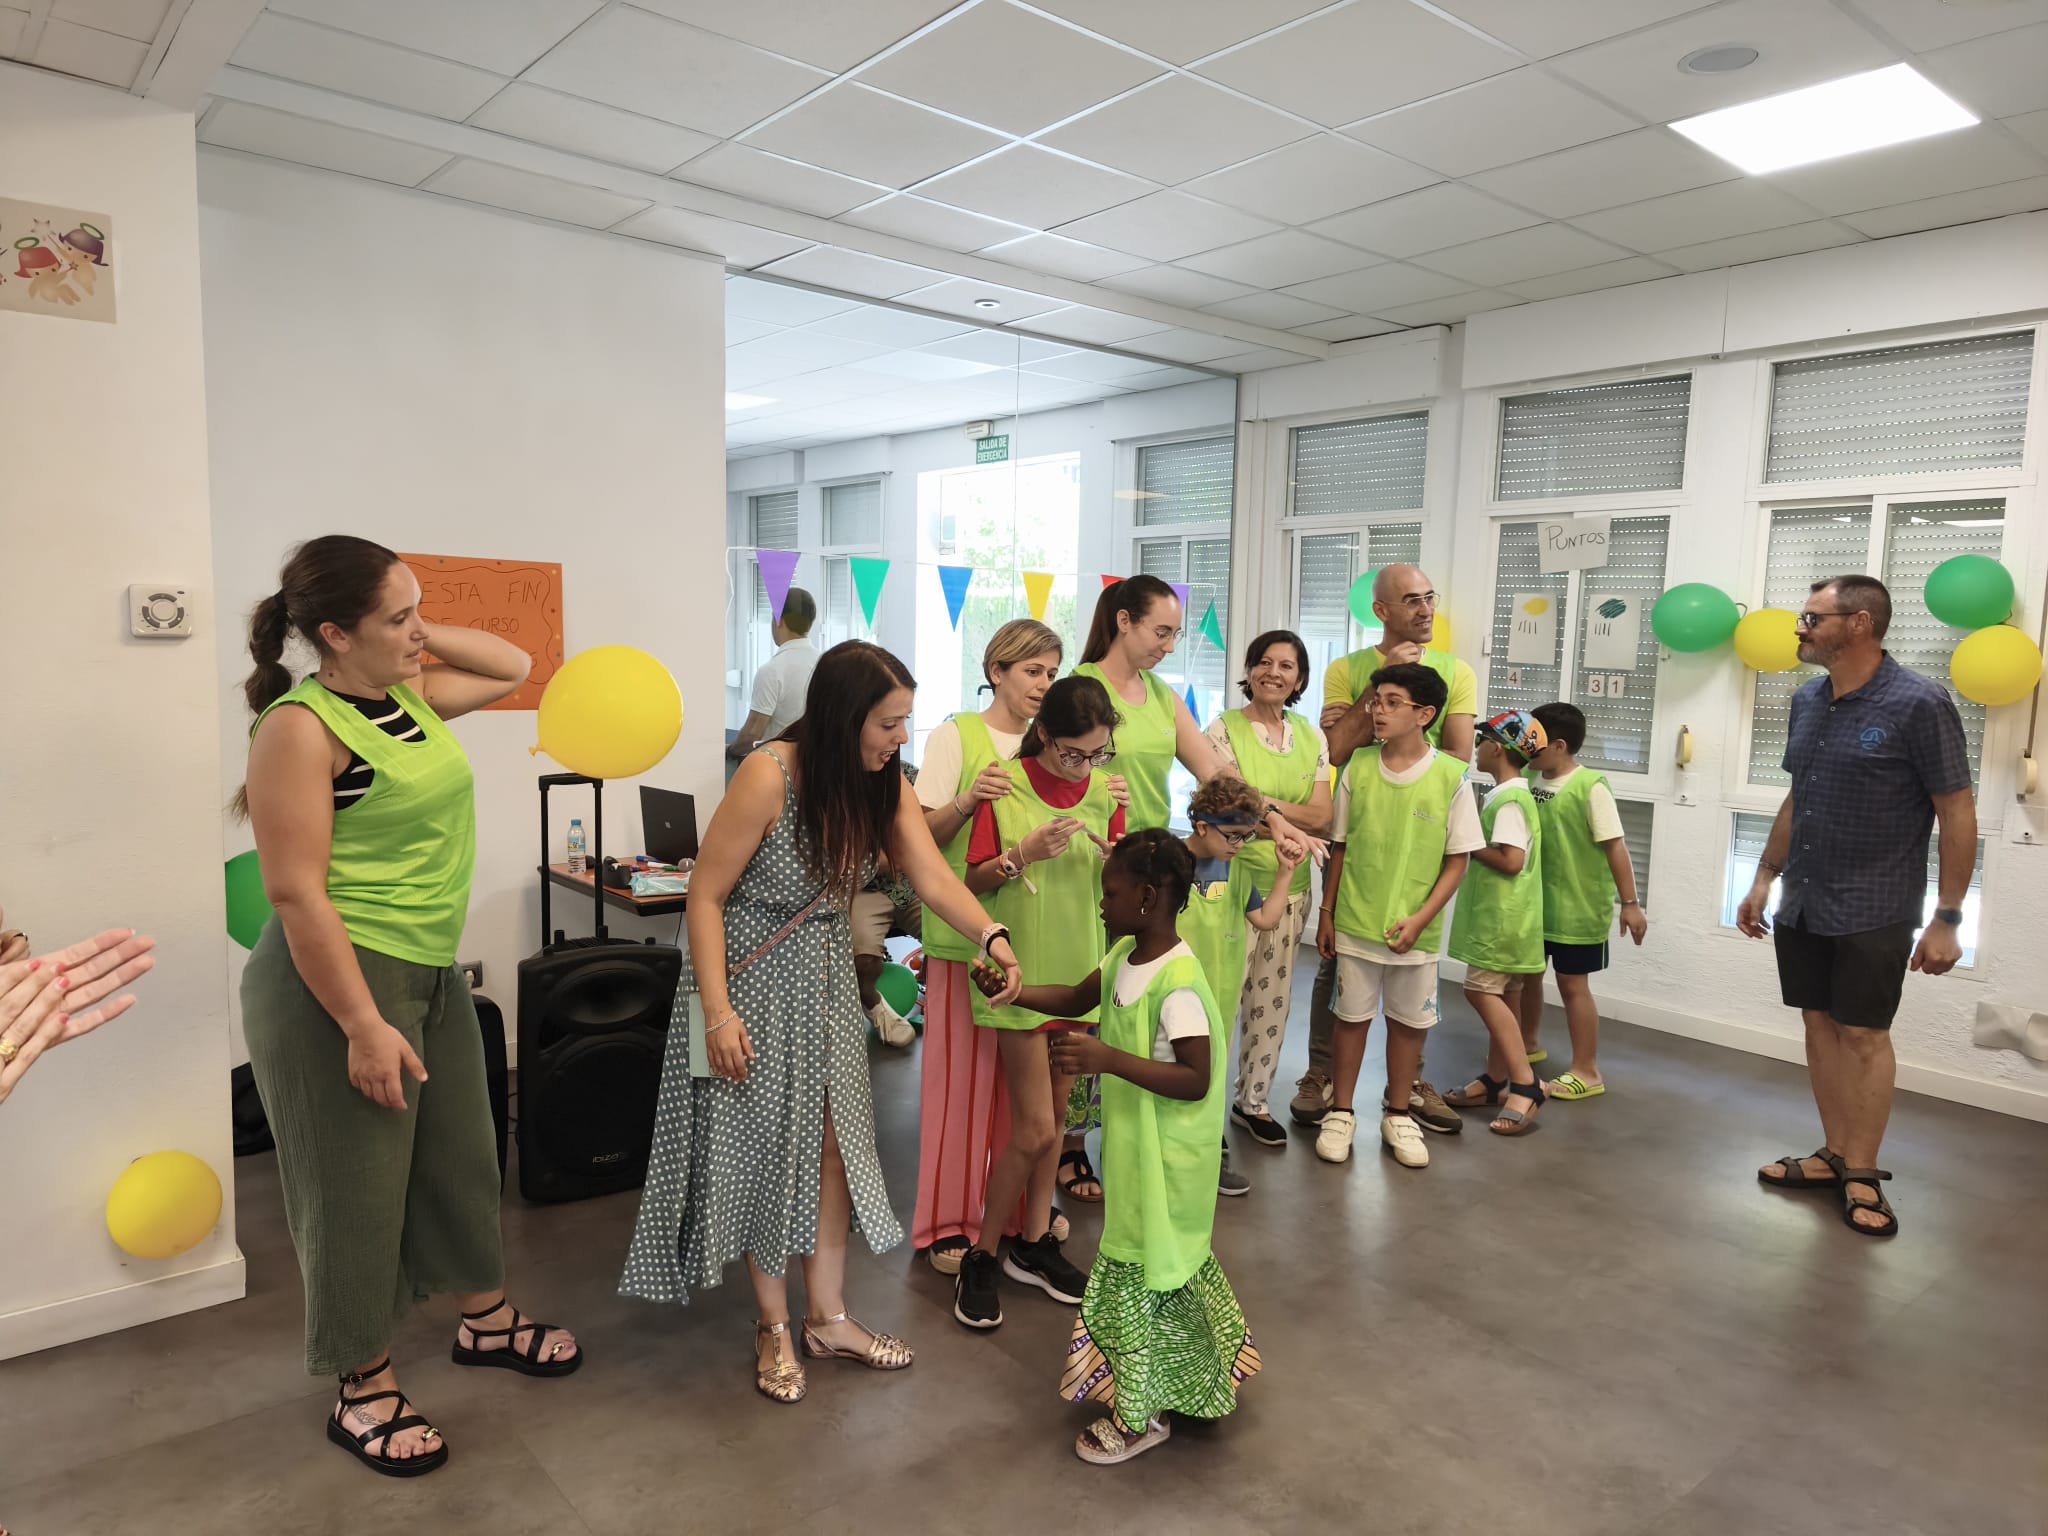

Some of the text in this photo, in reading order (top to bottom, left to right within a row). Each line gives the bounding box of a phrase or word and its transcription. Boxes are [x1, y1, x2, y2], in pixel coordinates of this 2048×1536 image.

[979, 437, 1007, 451] SALIDA DE
[420, 581, 542, 605] ESTA FIN
[468, 616, 520, 634] CURSO
[1508, 672, 1518, 684] 4
